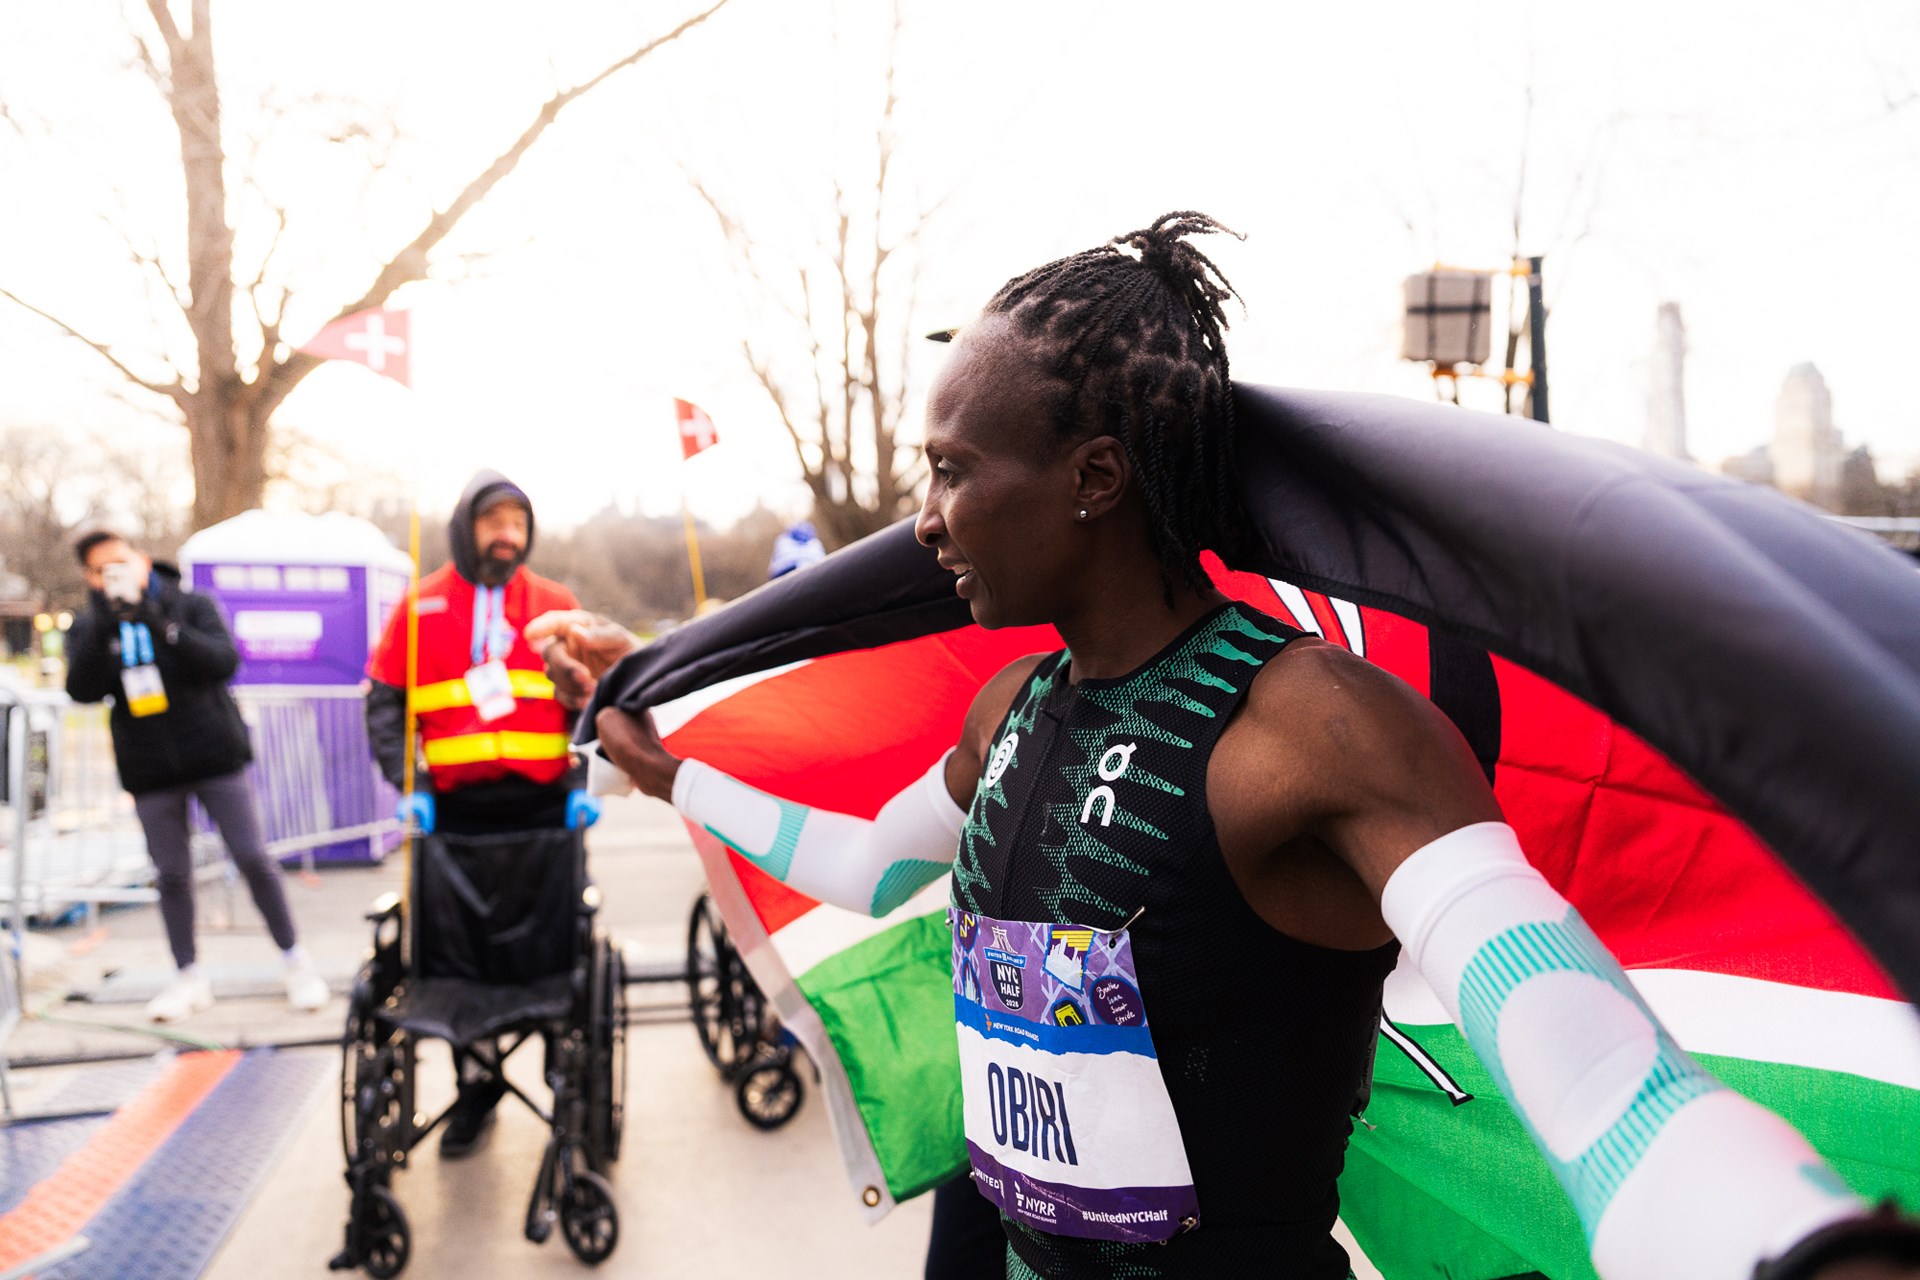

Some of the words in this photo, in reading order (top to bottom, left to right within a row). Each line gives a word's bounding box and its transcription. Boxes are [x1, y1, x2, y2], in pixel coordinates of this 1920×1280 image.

[996, 963, 1019, 984] NYC
[1000, 982, 1020, 997] HALF
[1115, 1010, 1136, 1026] Stride
[987, 1061, 1079, 1167] OBIRI
[974, 1166, 1000, 1189] UNITED
[1025, 1195, 1057, 1218] NYRR
[1082, 1209, 1168, 1224] #UnitedNYCHalf
